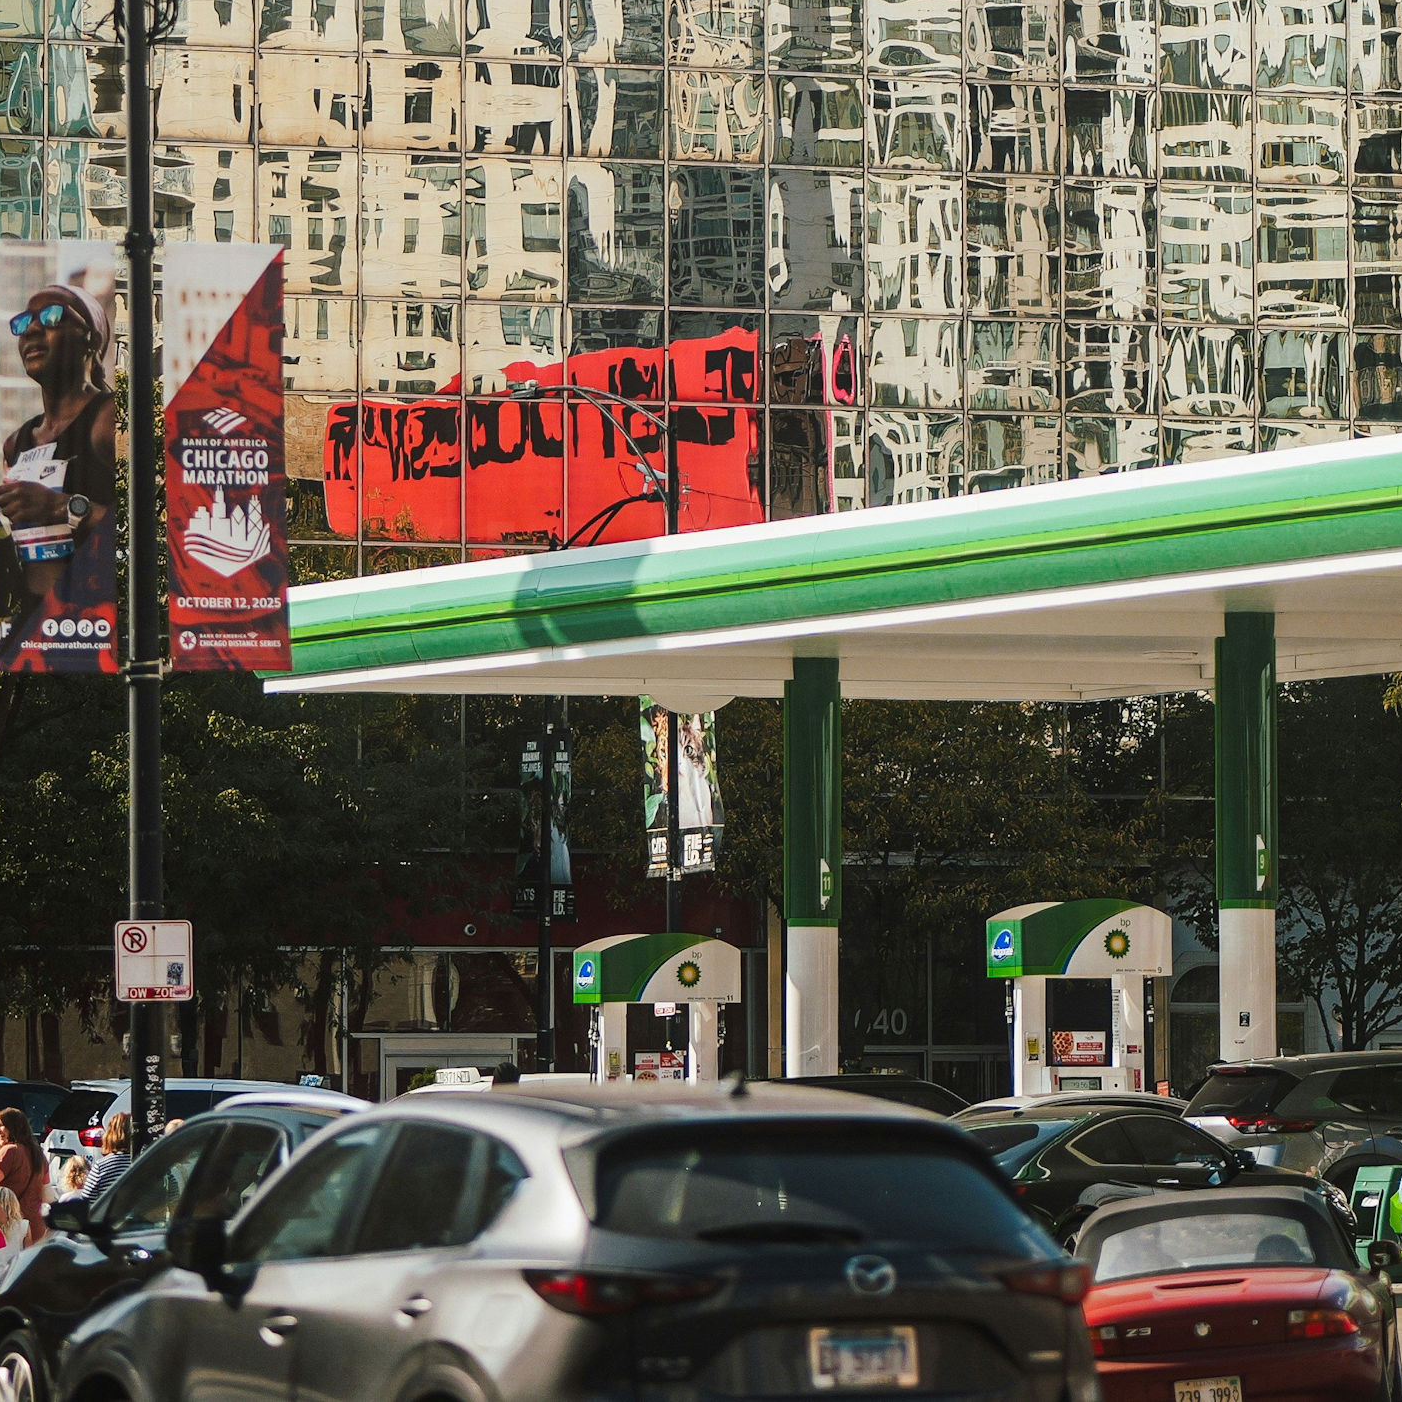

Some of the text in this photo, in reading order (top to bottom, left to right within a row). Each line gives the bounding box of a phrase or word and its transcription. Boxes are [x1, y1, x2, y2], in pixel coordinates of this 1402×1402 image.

[183, 438, 268, 447] BANK OF AMERICA
[182, 449, 269, 469] CHICAGO
[183, 470, 269, 485] MARATHON
[177, 597, 282, 610] OCTOBER 12, 2025
[21, 641, 112, 651] chicagomarathon.com
[1259, 854, 1265, 870] 9
[822, 876, 831, 891] 11
[1120, 917, 1131, 927] bp
[692, 951, 702, 959] bp
[129, 988, 148, 999] OW
[1125, 1327, 1152, 1337] Z3
